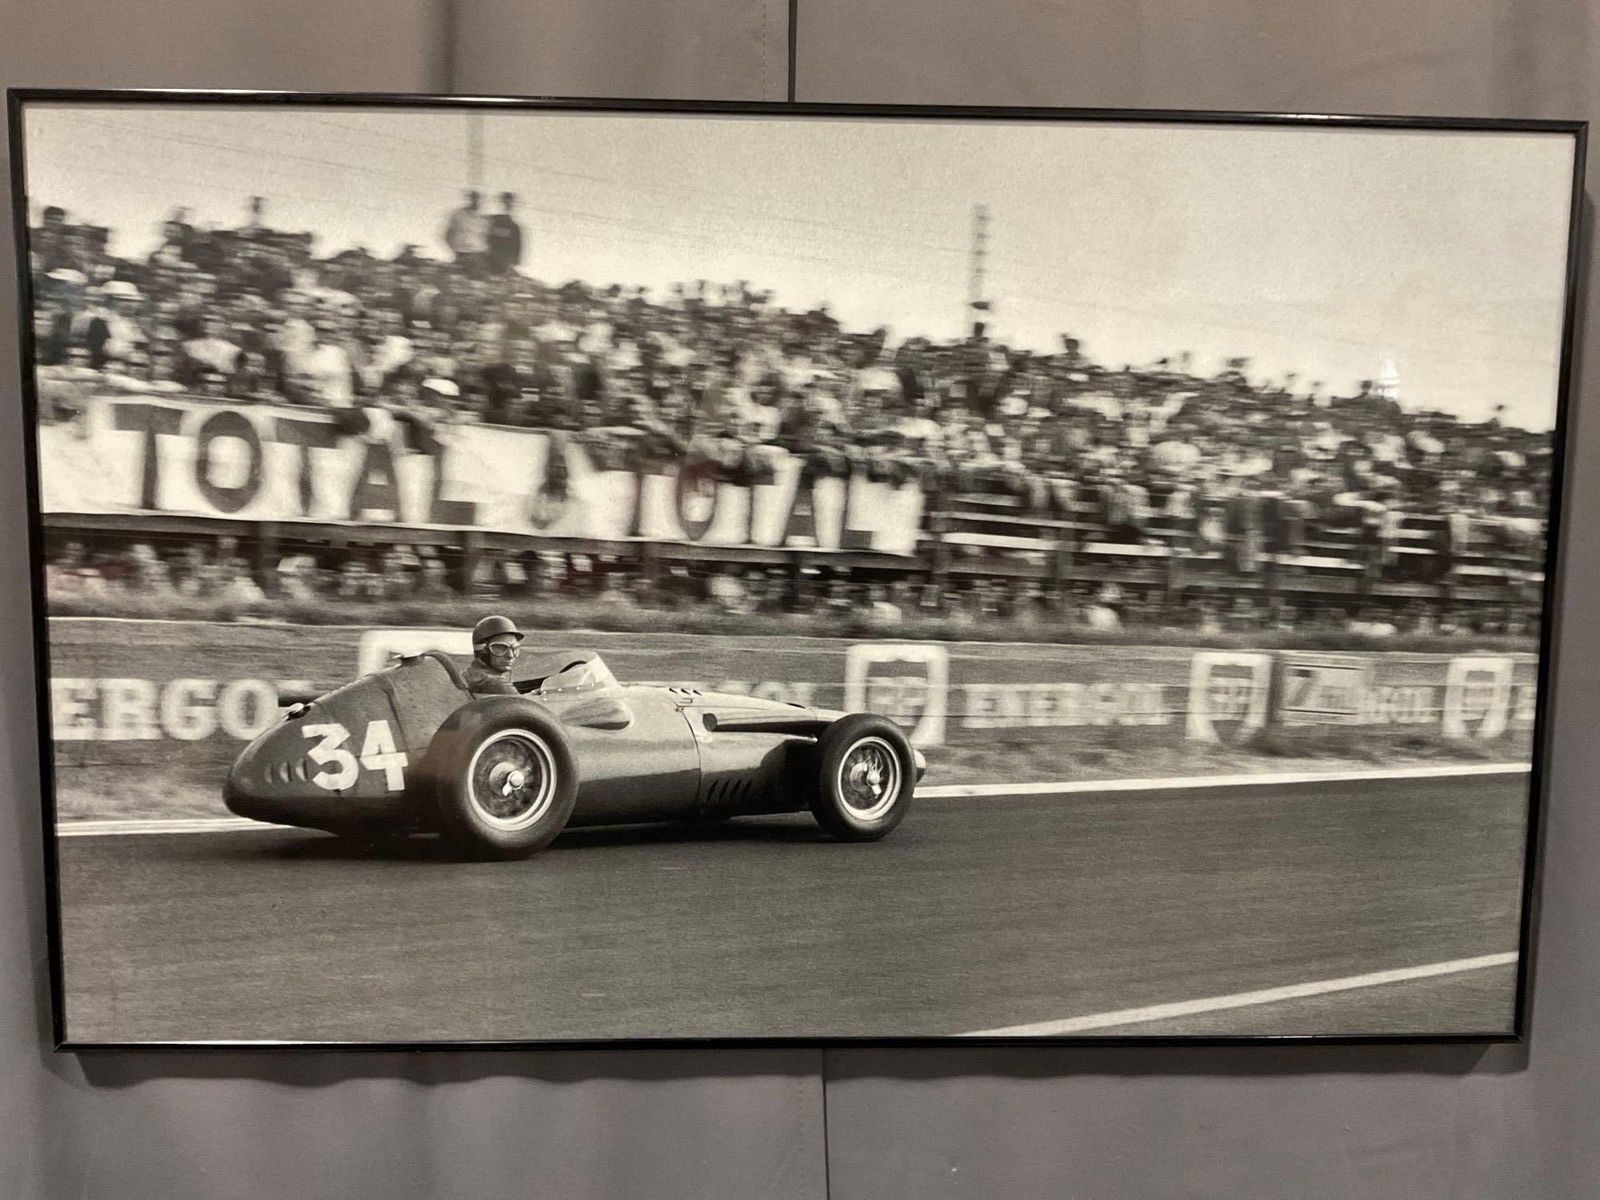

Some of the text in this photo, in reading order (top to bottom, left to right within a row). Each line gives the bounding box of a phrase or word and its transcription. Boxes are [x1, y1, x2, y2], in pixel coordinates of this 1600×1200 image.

[110, 403, 476, 525] TOTAL
[51, 678, 312, 741] ERGO
[302, 719, 409, 791] 34
